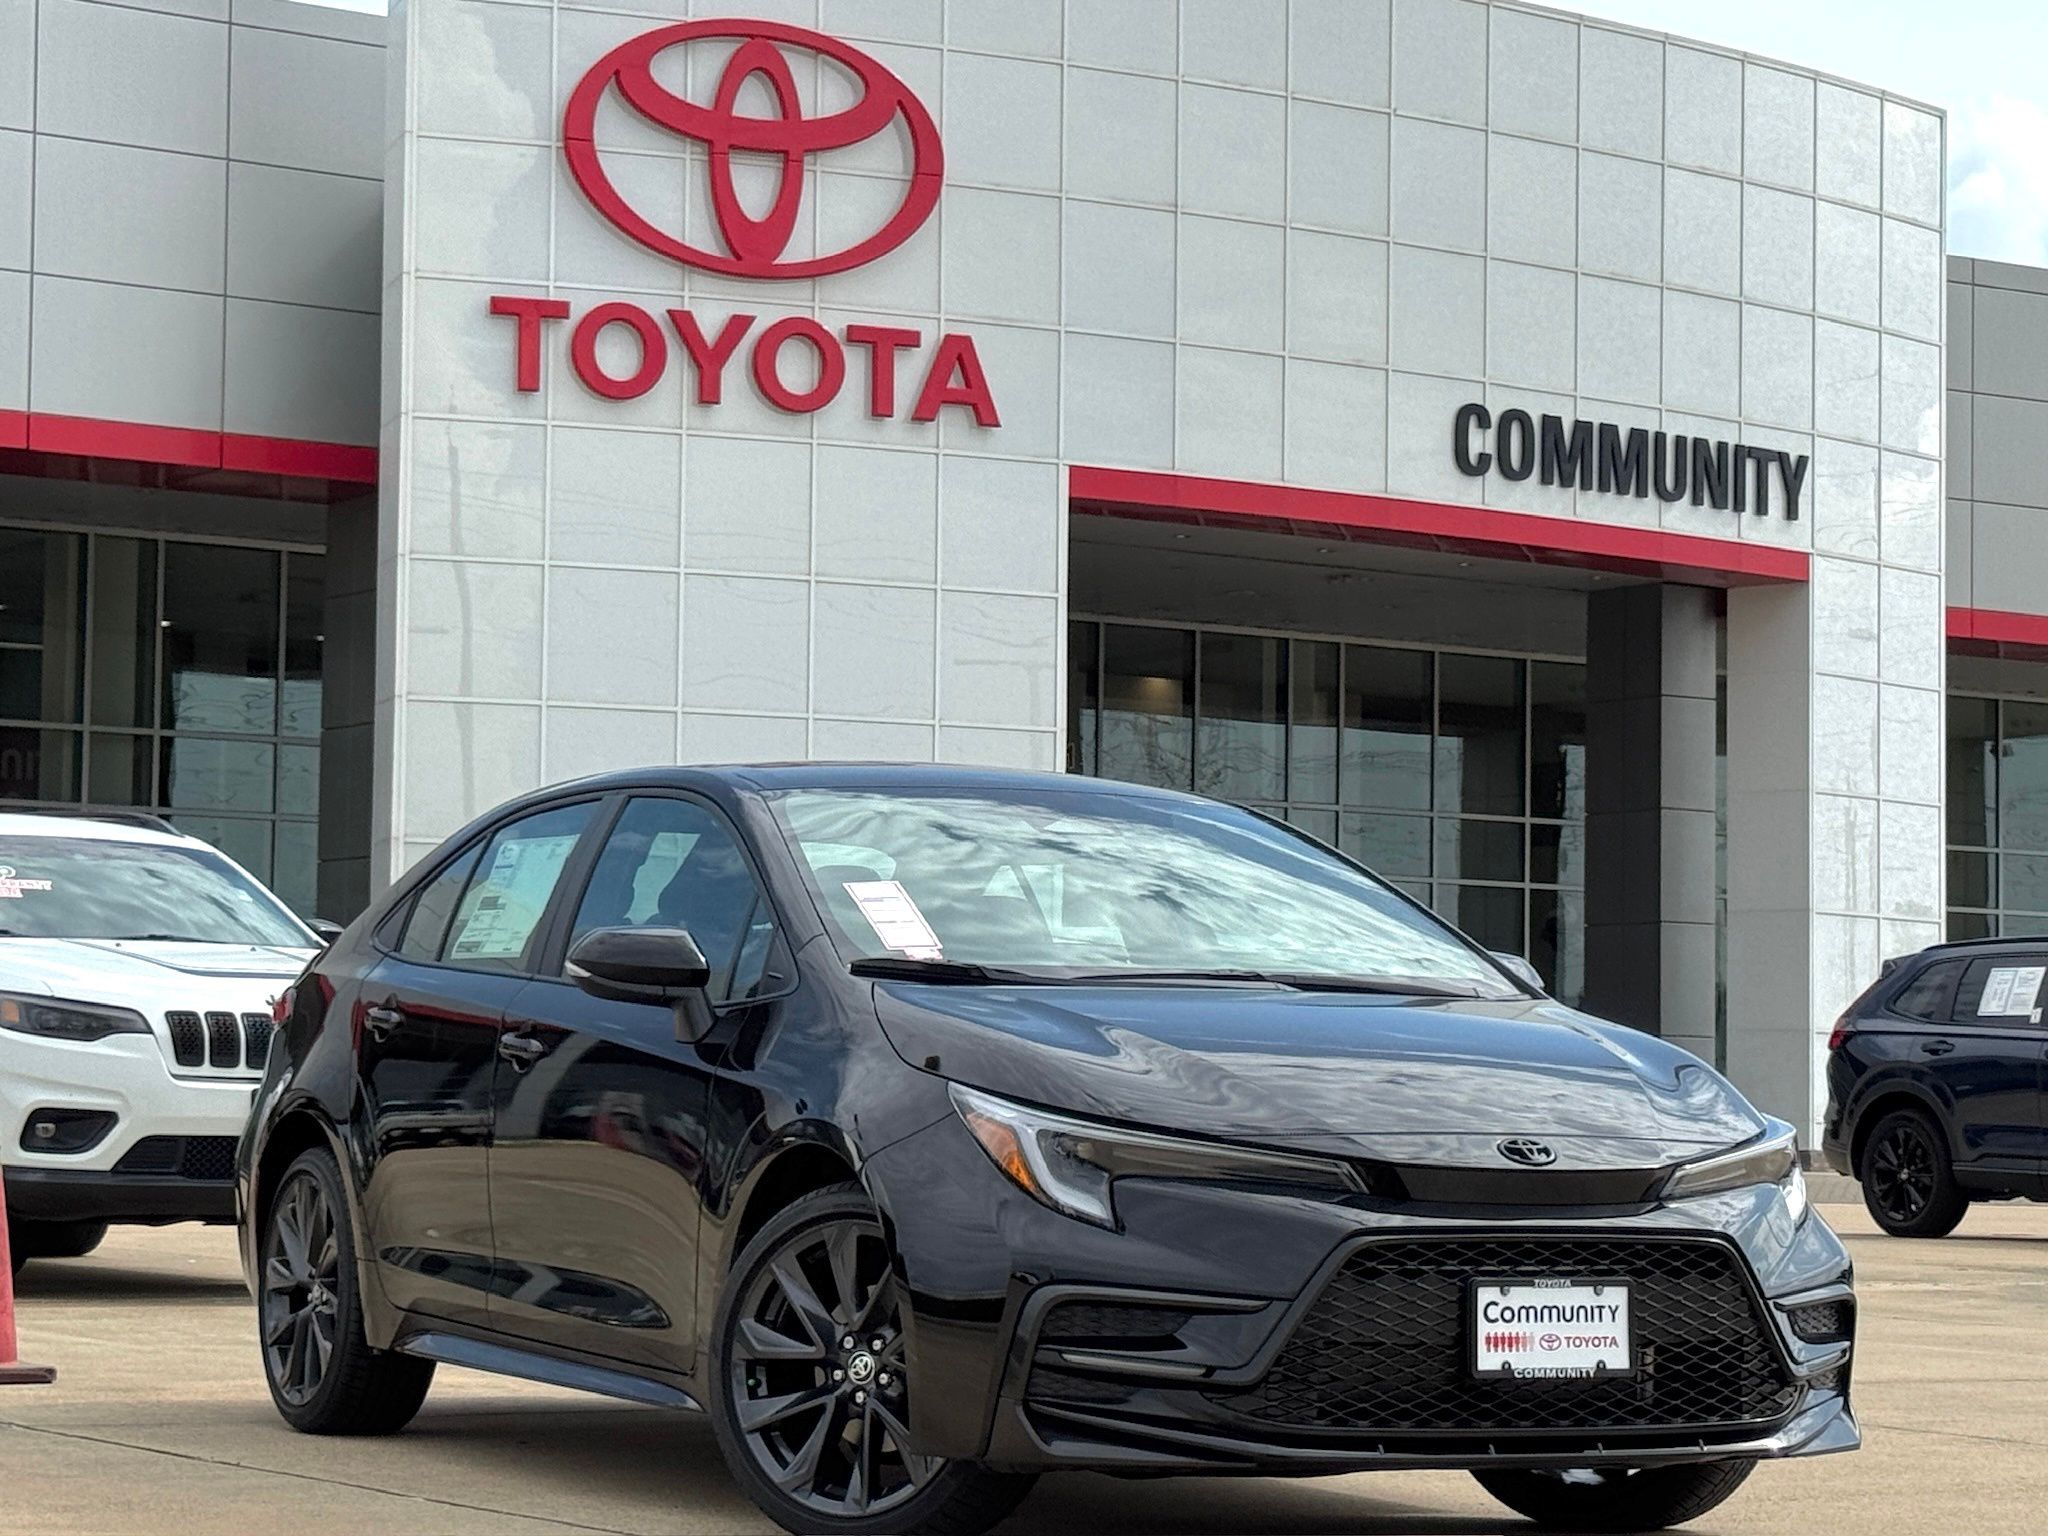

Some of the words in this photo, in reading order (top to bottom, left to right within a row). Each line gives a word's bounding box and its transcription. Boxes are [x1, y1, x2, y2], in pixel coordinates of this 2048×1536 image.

[490, 295, 1002, 428] TOYOTA
[1454, 403, 1810, 521] COMMUNITY
[1533, 1279, 1572, 1289] TOYOTA
[1564, 1336, 1620, 1348] TOYOTA
[1513, 1367, 1597, 1379] COMMUNITY
